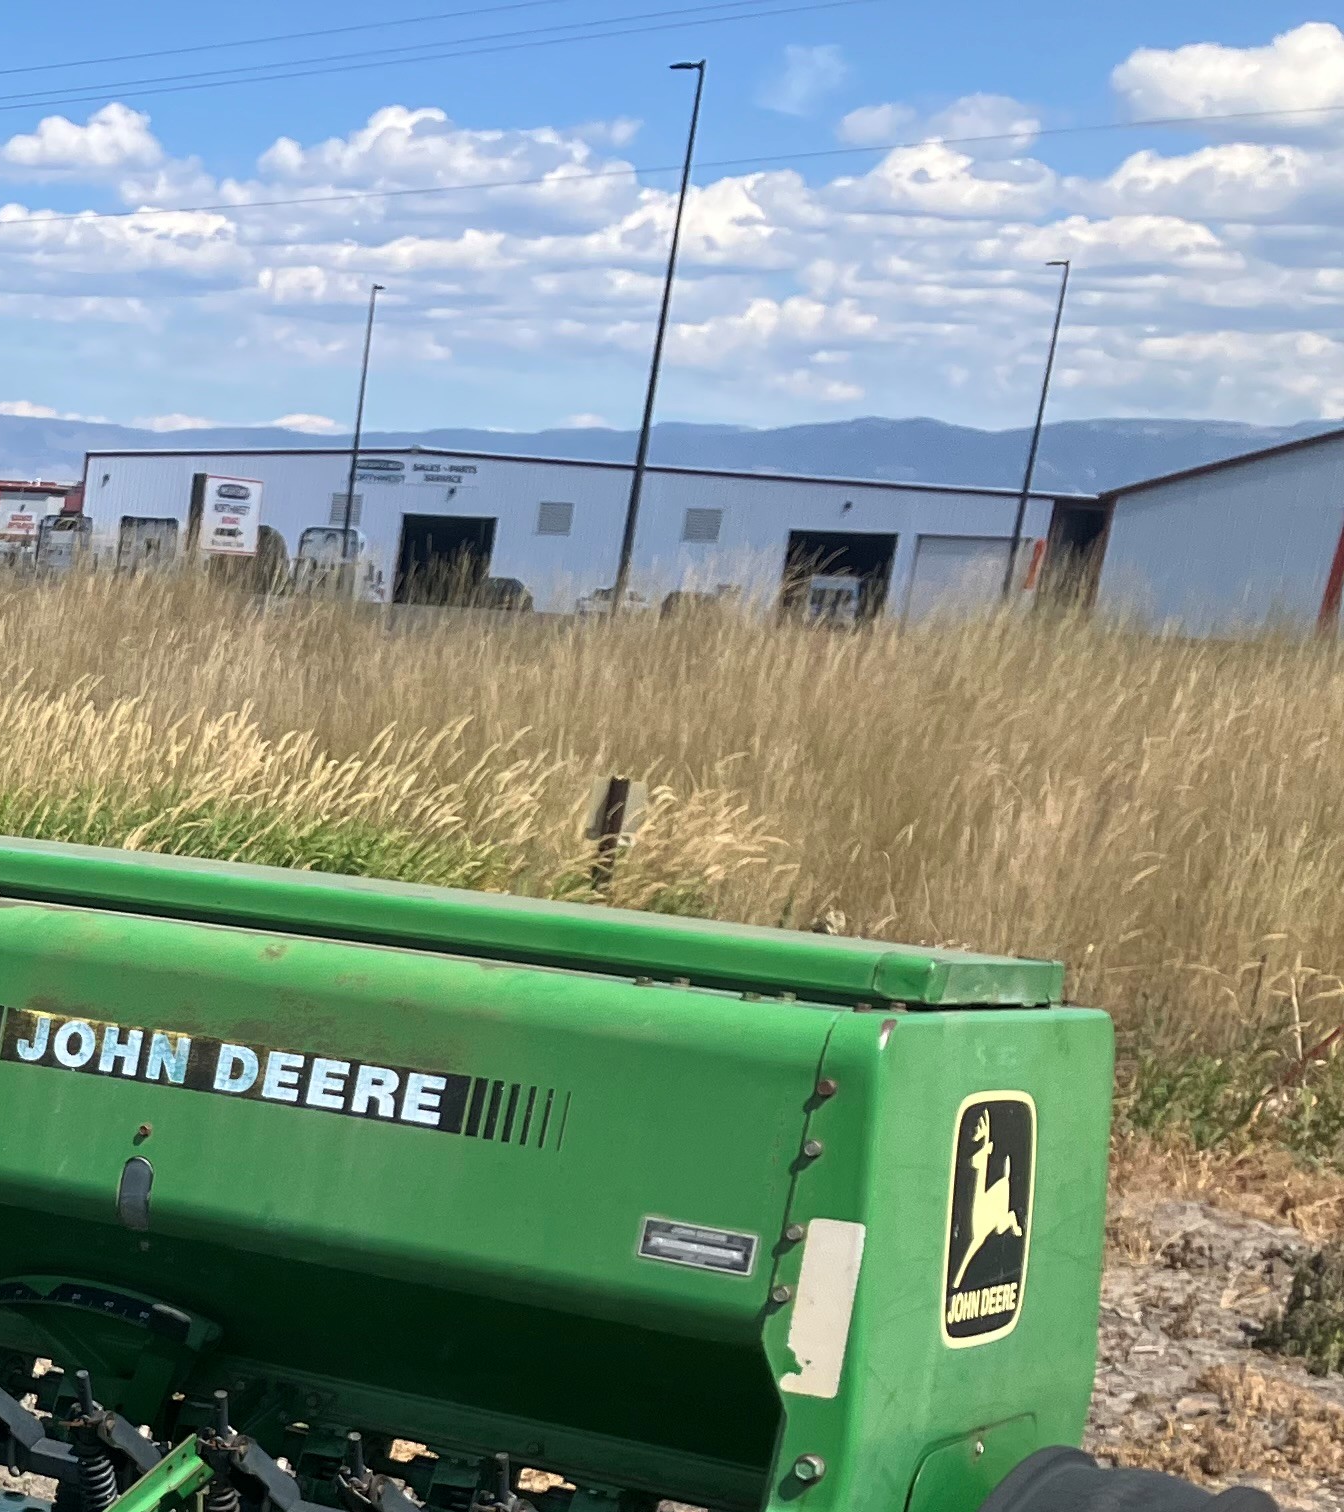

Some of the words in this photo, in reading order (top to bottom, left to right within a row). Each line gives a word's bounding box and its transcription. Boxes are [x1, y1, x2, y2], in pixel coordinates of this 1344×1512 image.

[17, 1016, 191, 1084] JOHN
[213, 1043, 437, 1125] DEERE
[947, 1289, 981, 1324] JOHN
[980, 1282, 1018, 1317] DEERE
